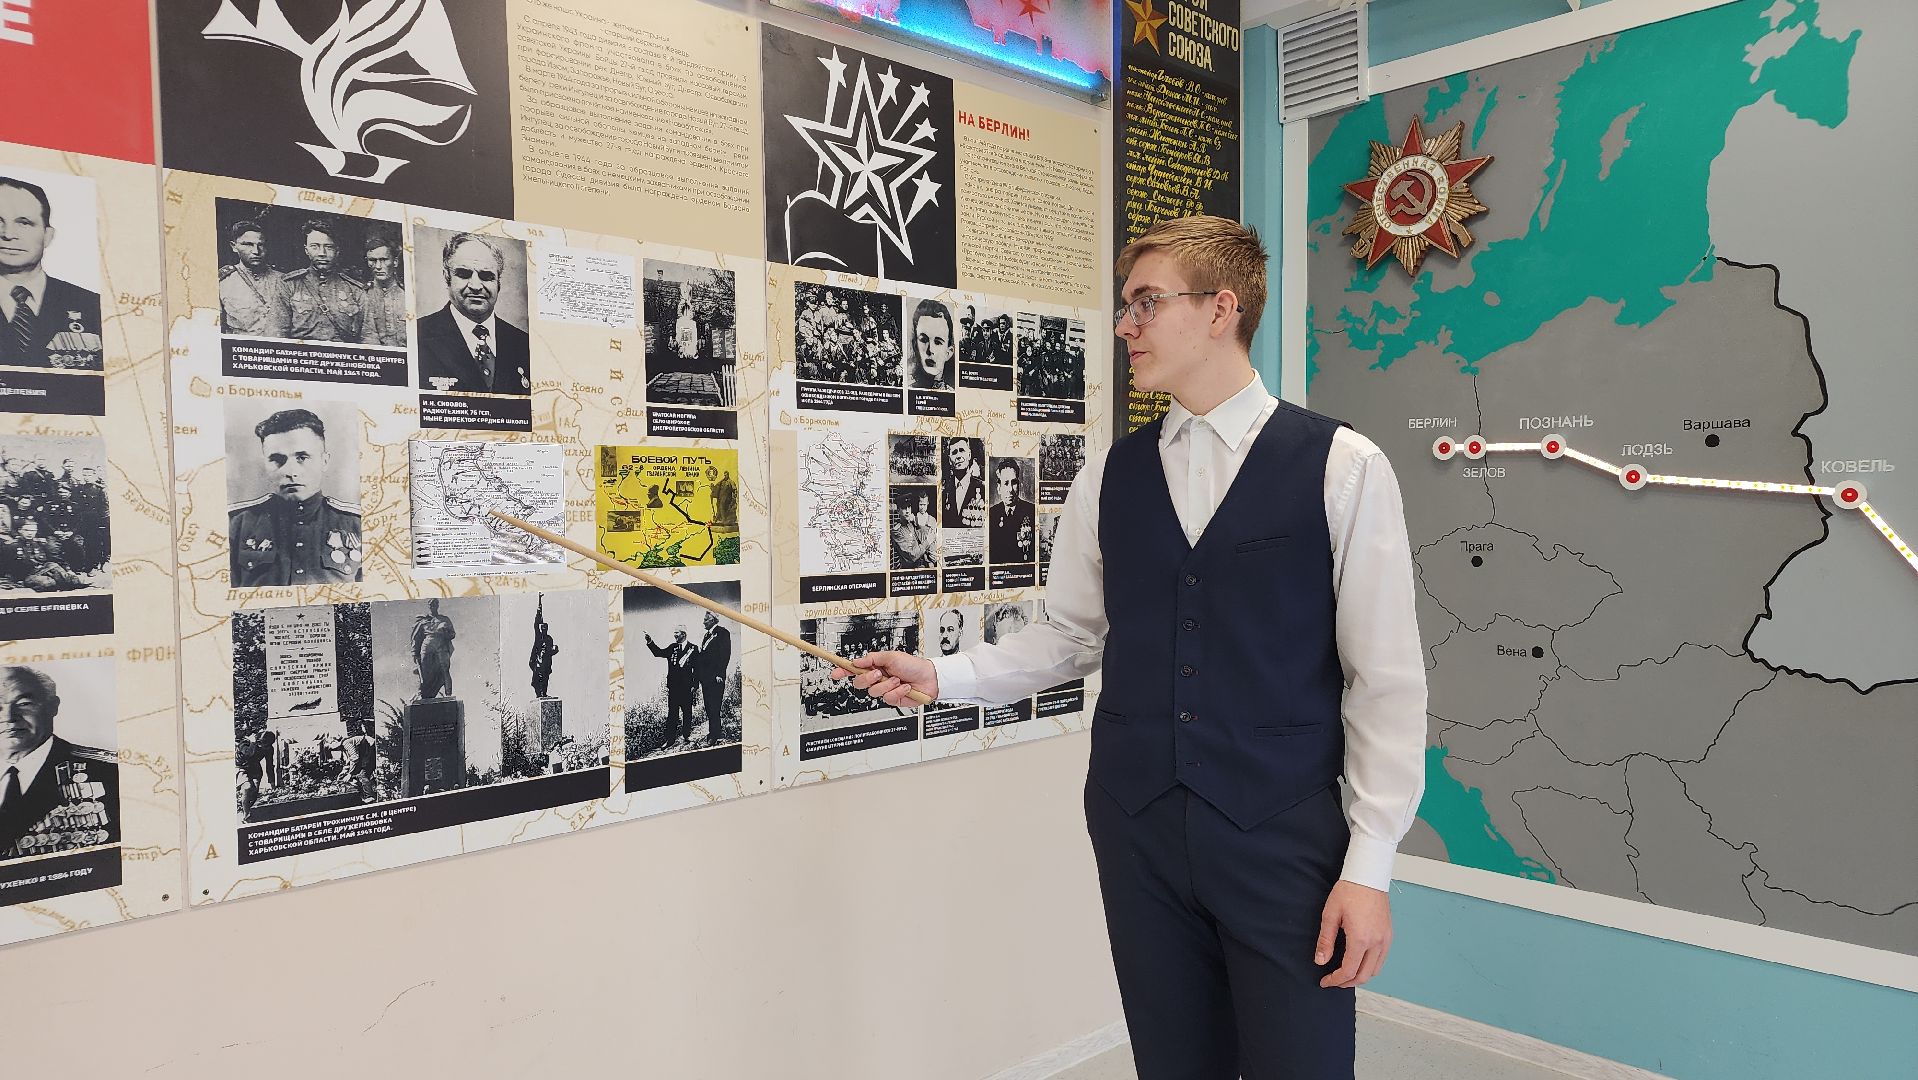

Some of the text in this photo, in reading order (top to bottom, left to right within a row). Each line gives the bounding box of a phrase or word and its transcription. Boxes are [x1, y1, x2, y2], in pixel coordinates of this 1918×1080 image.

[1168, 0, 1239, 52] СОВЕТСКОГО
[1168, 32, 1216, 72] СОЮЗА.
[958, 110, 1030, 141] НА БЕРЛИН!
[1377, 157, 1437, 229] ОТЕЧЕСТВЕННАЯ
[238, 354, 292, 364] ТОВАРИЩАМИ
[232, 363, 288, 373] ХАРЬКОВСКОЙ
[327, 368, 342, 376] МАЙ
[229, 385, 303, 400] Борнхольм
[572, 381, 604, 394] Ковно
[1408, 417, 1457, 429] БЕРЛИН
[1519, 415, 1594, 429] ПОЗНАНЬ
[1683, 417, 1751, 432] Варшава
[1621, 443, 1674, 457] ЛОДЗЬ
[631, 455, 712, 465] БОЕВОЙ ПУТЬ
[1821, 459, 1895, 474] КОВЕЛЬ
[1462, 467, 1506, 478] ЗЕЛОВ
[1460, 540, 1494, 553] Прага
[226, 587, 293, 601] Познань
[812, 582, 877, 592] БЕРЛИНСКАЯ ОПЕРАЦИЯ
[1497, 645, 1527, 657] Вена
[248, 828, 290, 840] КОМАНДИР
[323, 816, 364, 828] ТРОХИМЧУК
[388, 806, 417, 817] ЦЕНТРЕ)
[248, 841, 303, 856] ХАРЬКОВСКОЙ
[340, 831, 356, 840] МАЙ
[374, 825, 393, 835] ГОДА.
[254, 832, 306, 847] ТОВАРИЩАМИ
[70, 867, 94, 879] ГОДУ
